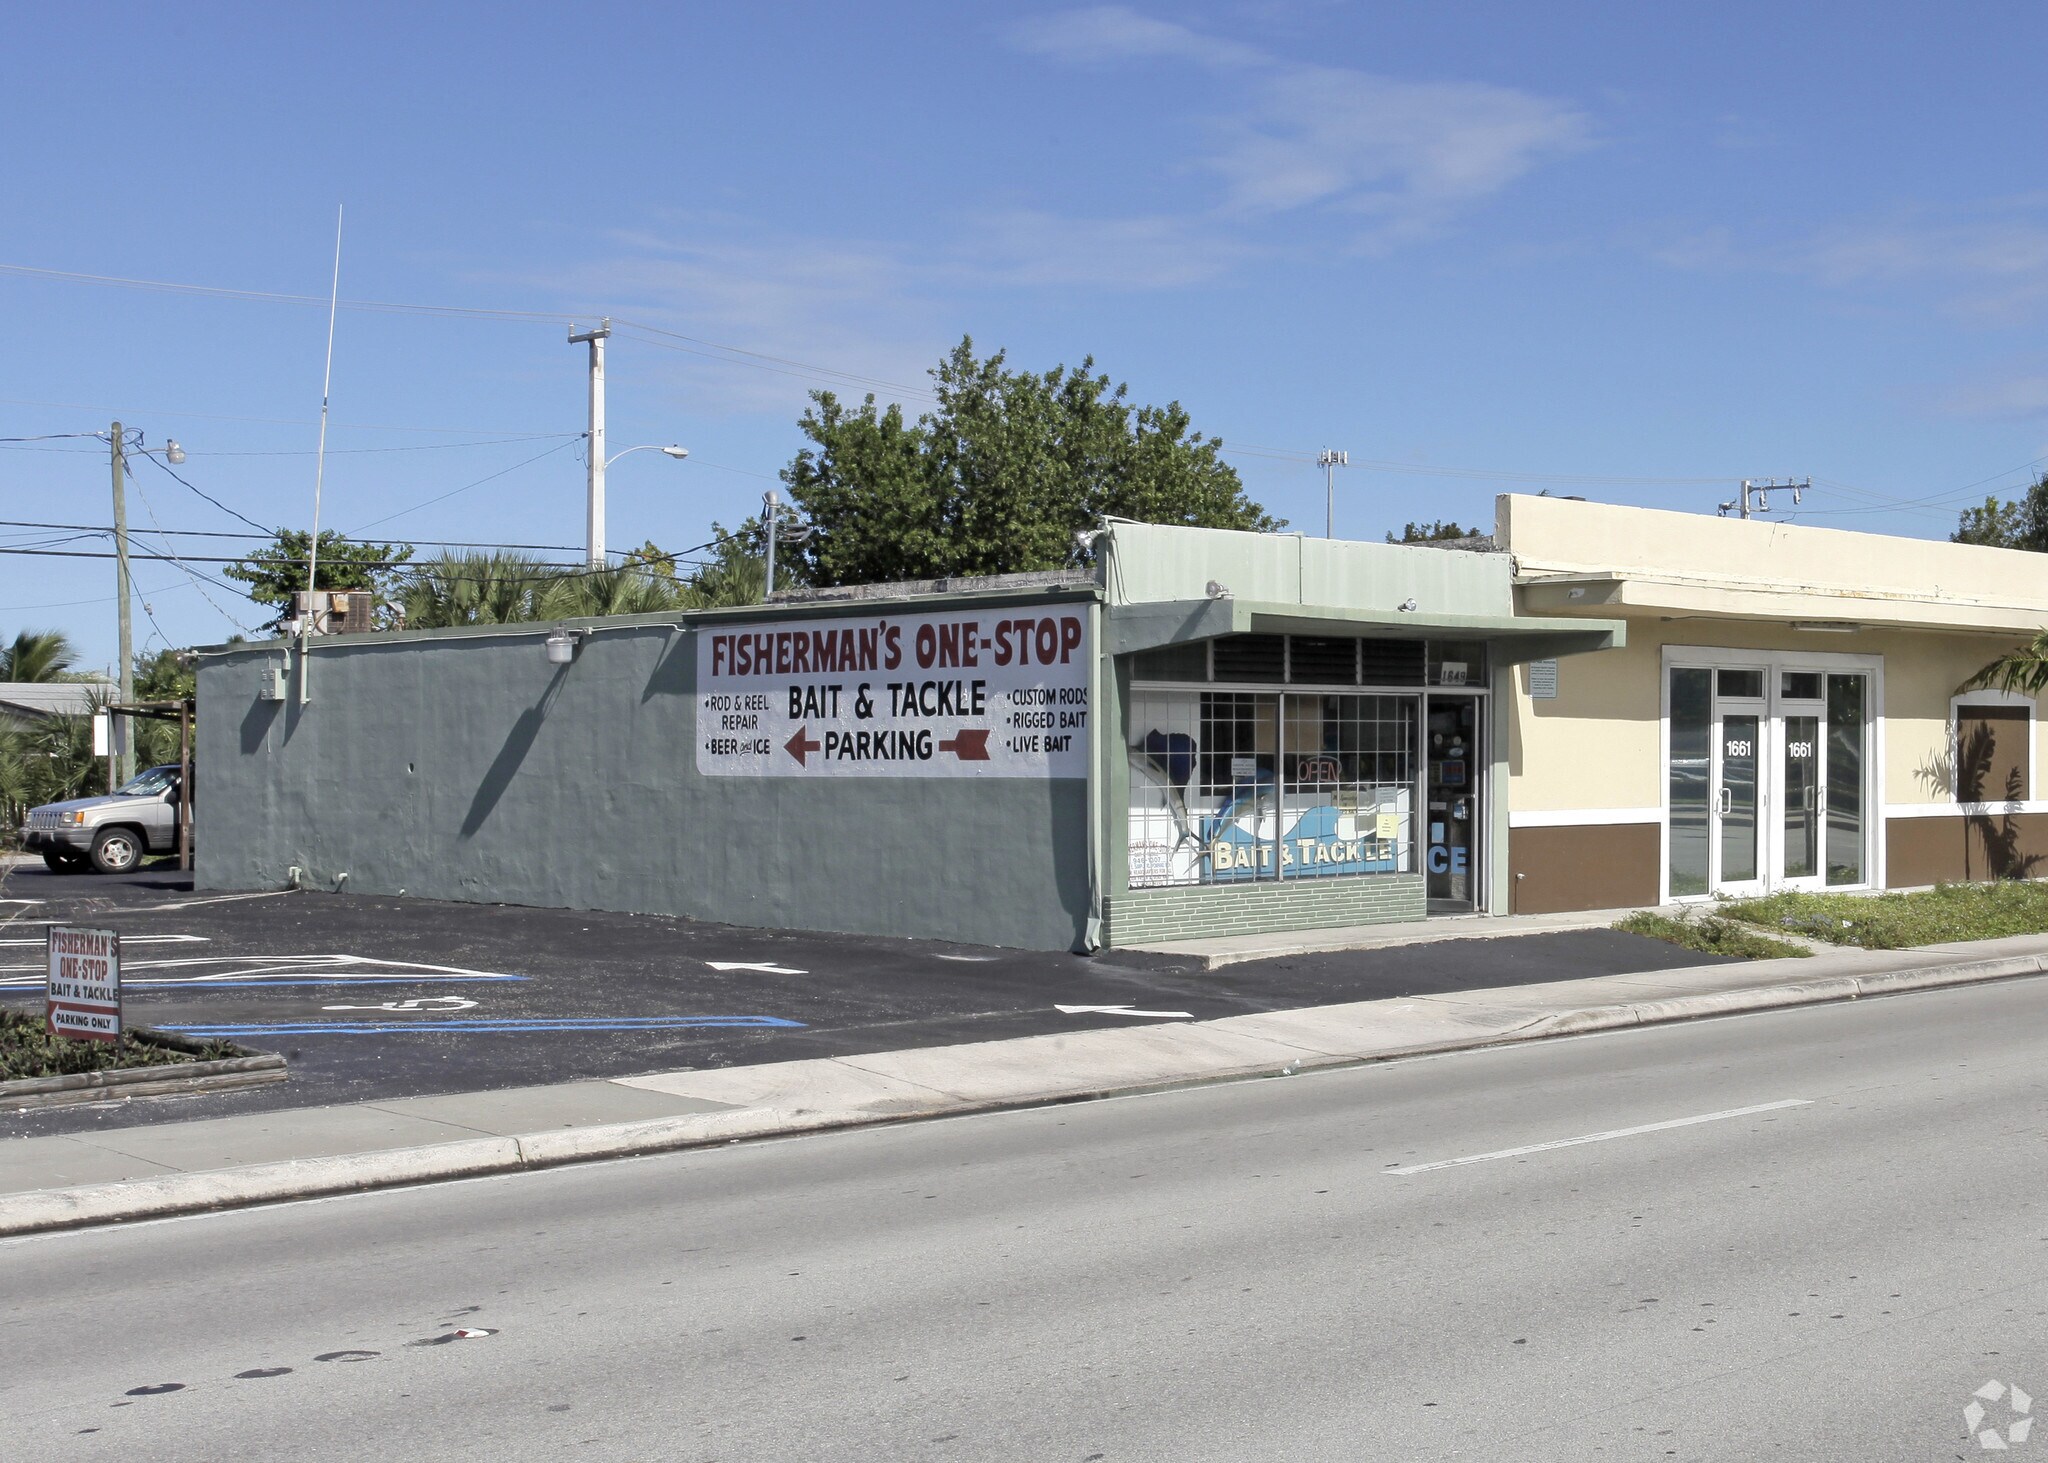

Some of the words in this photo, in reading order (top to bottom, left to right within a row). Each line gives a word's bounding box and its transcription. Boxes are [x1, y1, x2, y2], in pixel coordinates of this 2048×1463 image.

[712, 620, 902, 676] FISHERMAN'S
[916, 617, 1082, 669] ONE-STOP
[711, 696, 731, 711] ROD
[734, 695, 742, 711] &
[745, 695, 769, 710] REEL
[789, 684, 843, 719] BAIT
[855, 682, 874, 719] &
[887, 679, 986, 717] TACKLE
[1012, 688, 1056, 706] CUSTOM
[722, 714, 758, 730] REPAIR
[1013, 712, 1055, 728] RIGGED
[1060, 711, 1087, 728] BAIT
[711, 739, 738, 755] BEER
[753, 739, 770, 754] ICE
[825, 729, 933, 760] PARKING
[1013, 735, 1039, 752] LIVE
[1044, 735, 1072, 752] BAIT
[1727, 740, 1751, 757] 1661
[1788, 742, 1812, 758] 1661
[1298, 761, 1339, 782] OPEN
[1214, 841, 1272, 869] BAIT
[1281, 844, 1294, 865] &
[1297, 838, 1393, 866] TACKLE
[1427, 846, 1466, 874] CE
[52, 932, 118, 958] FISHERMAN'S
[60, 957, 108, 982] ONE-STOP
[51, 983, 70, 997] BAIT
[73, 985, 81, 998] &
[83, 986, 118, 1001] TACKLE
[56, 1013, 89, 1027] PARKING
[91, 1018, 111, 1029] ONLY
